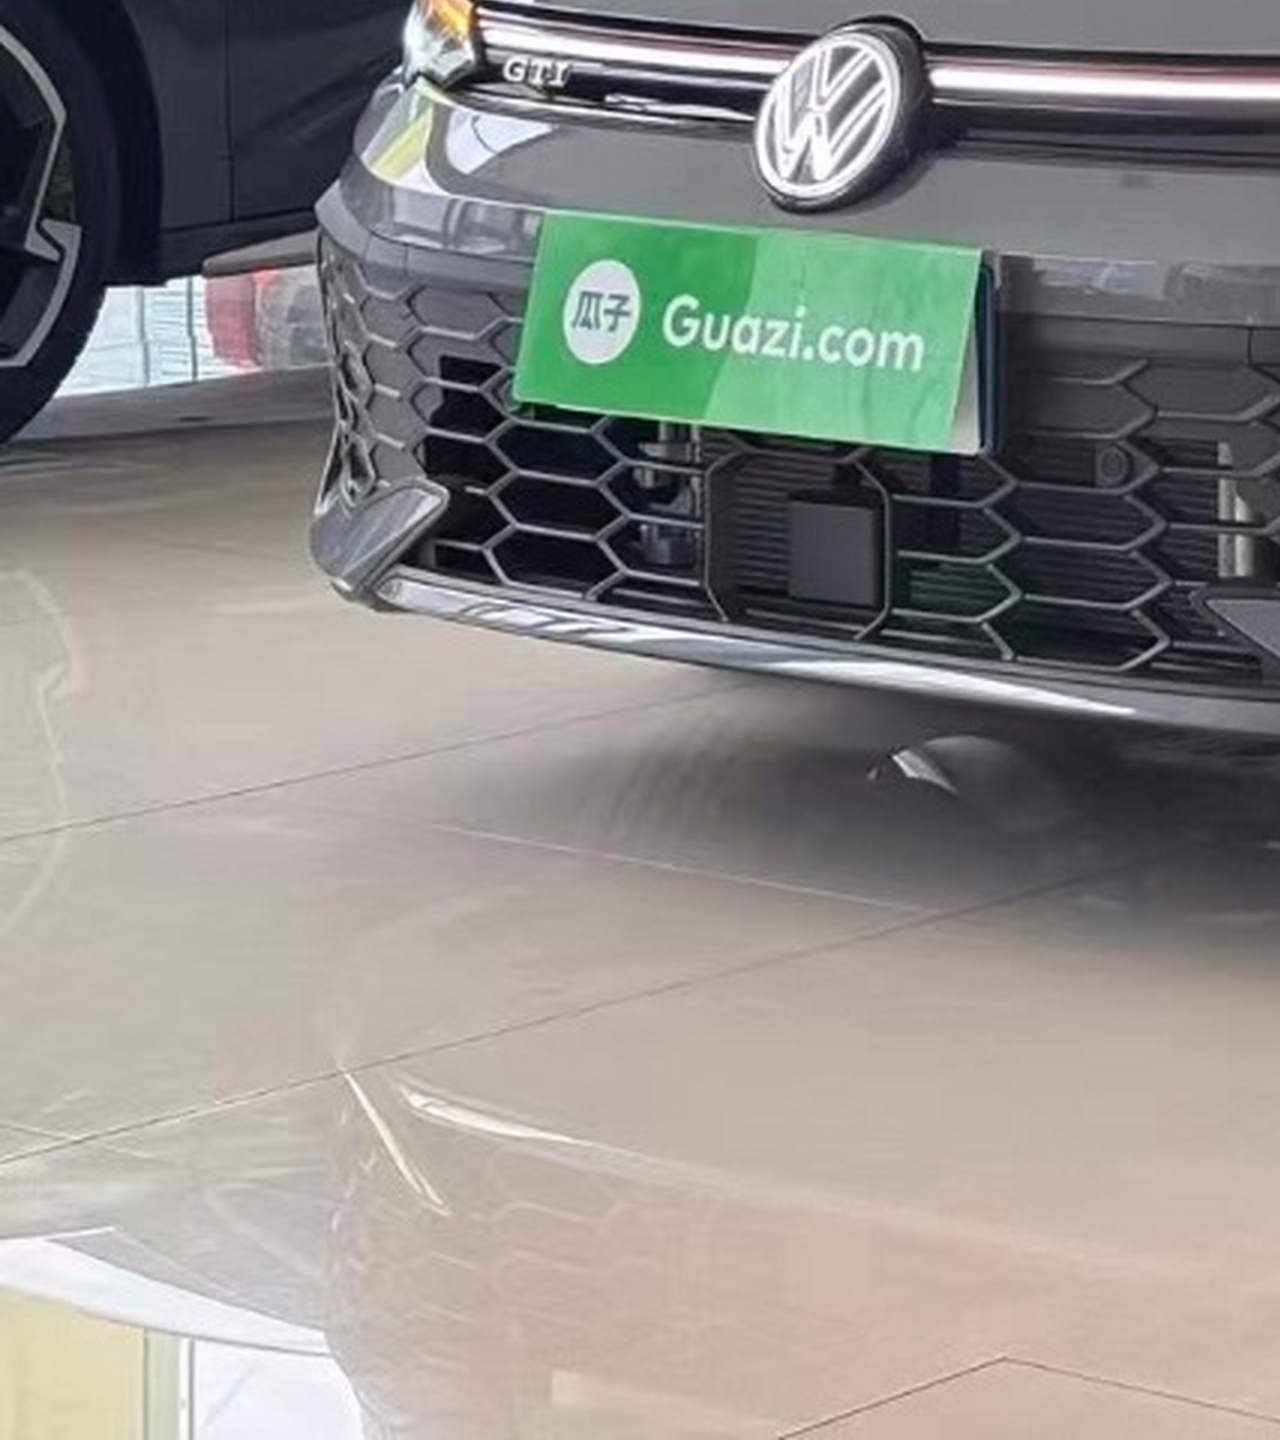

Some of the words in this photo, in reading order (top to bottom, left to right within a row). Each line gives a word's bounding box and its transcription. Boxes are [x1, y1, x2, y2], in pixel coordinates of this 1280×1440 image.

[502, 55, 571, 88] GTI
[571, 290, 631, 332] 瓜子
[662, 293, 925, 372] Guazi.com
